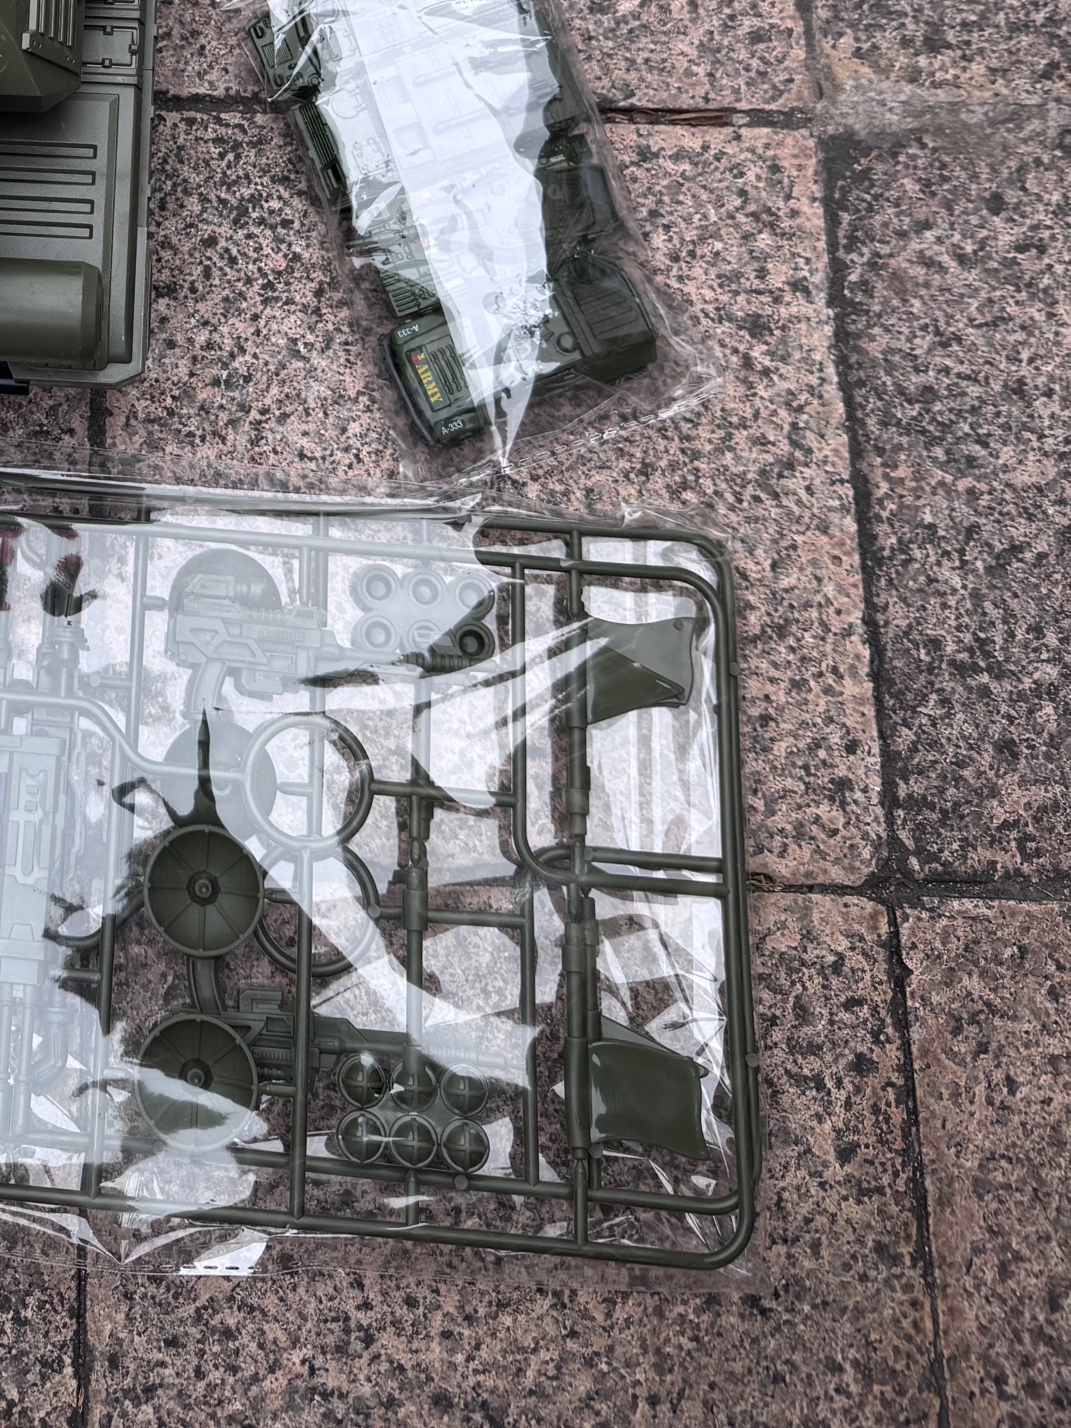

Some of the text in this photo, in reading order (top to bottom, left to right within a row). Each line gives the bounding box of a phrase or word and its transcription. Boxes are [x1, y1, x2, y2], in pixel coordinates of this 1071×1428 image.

[397, 324, 419, 338] A-333
[415, 364, 443, 403] ARMY
[441, 419, 463, 435] A-333
